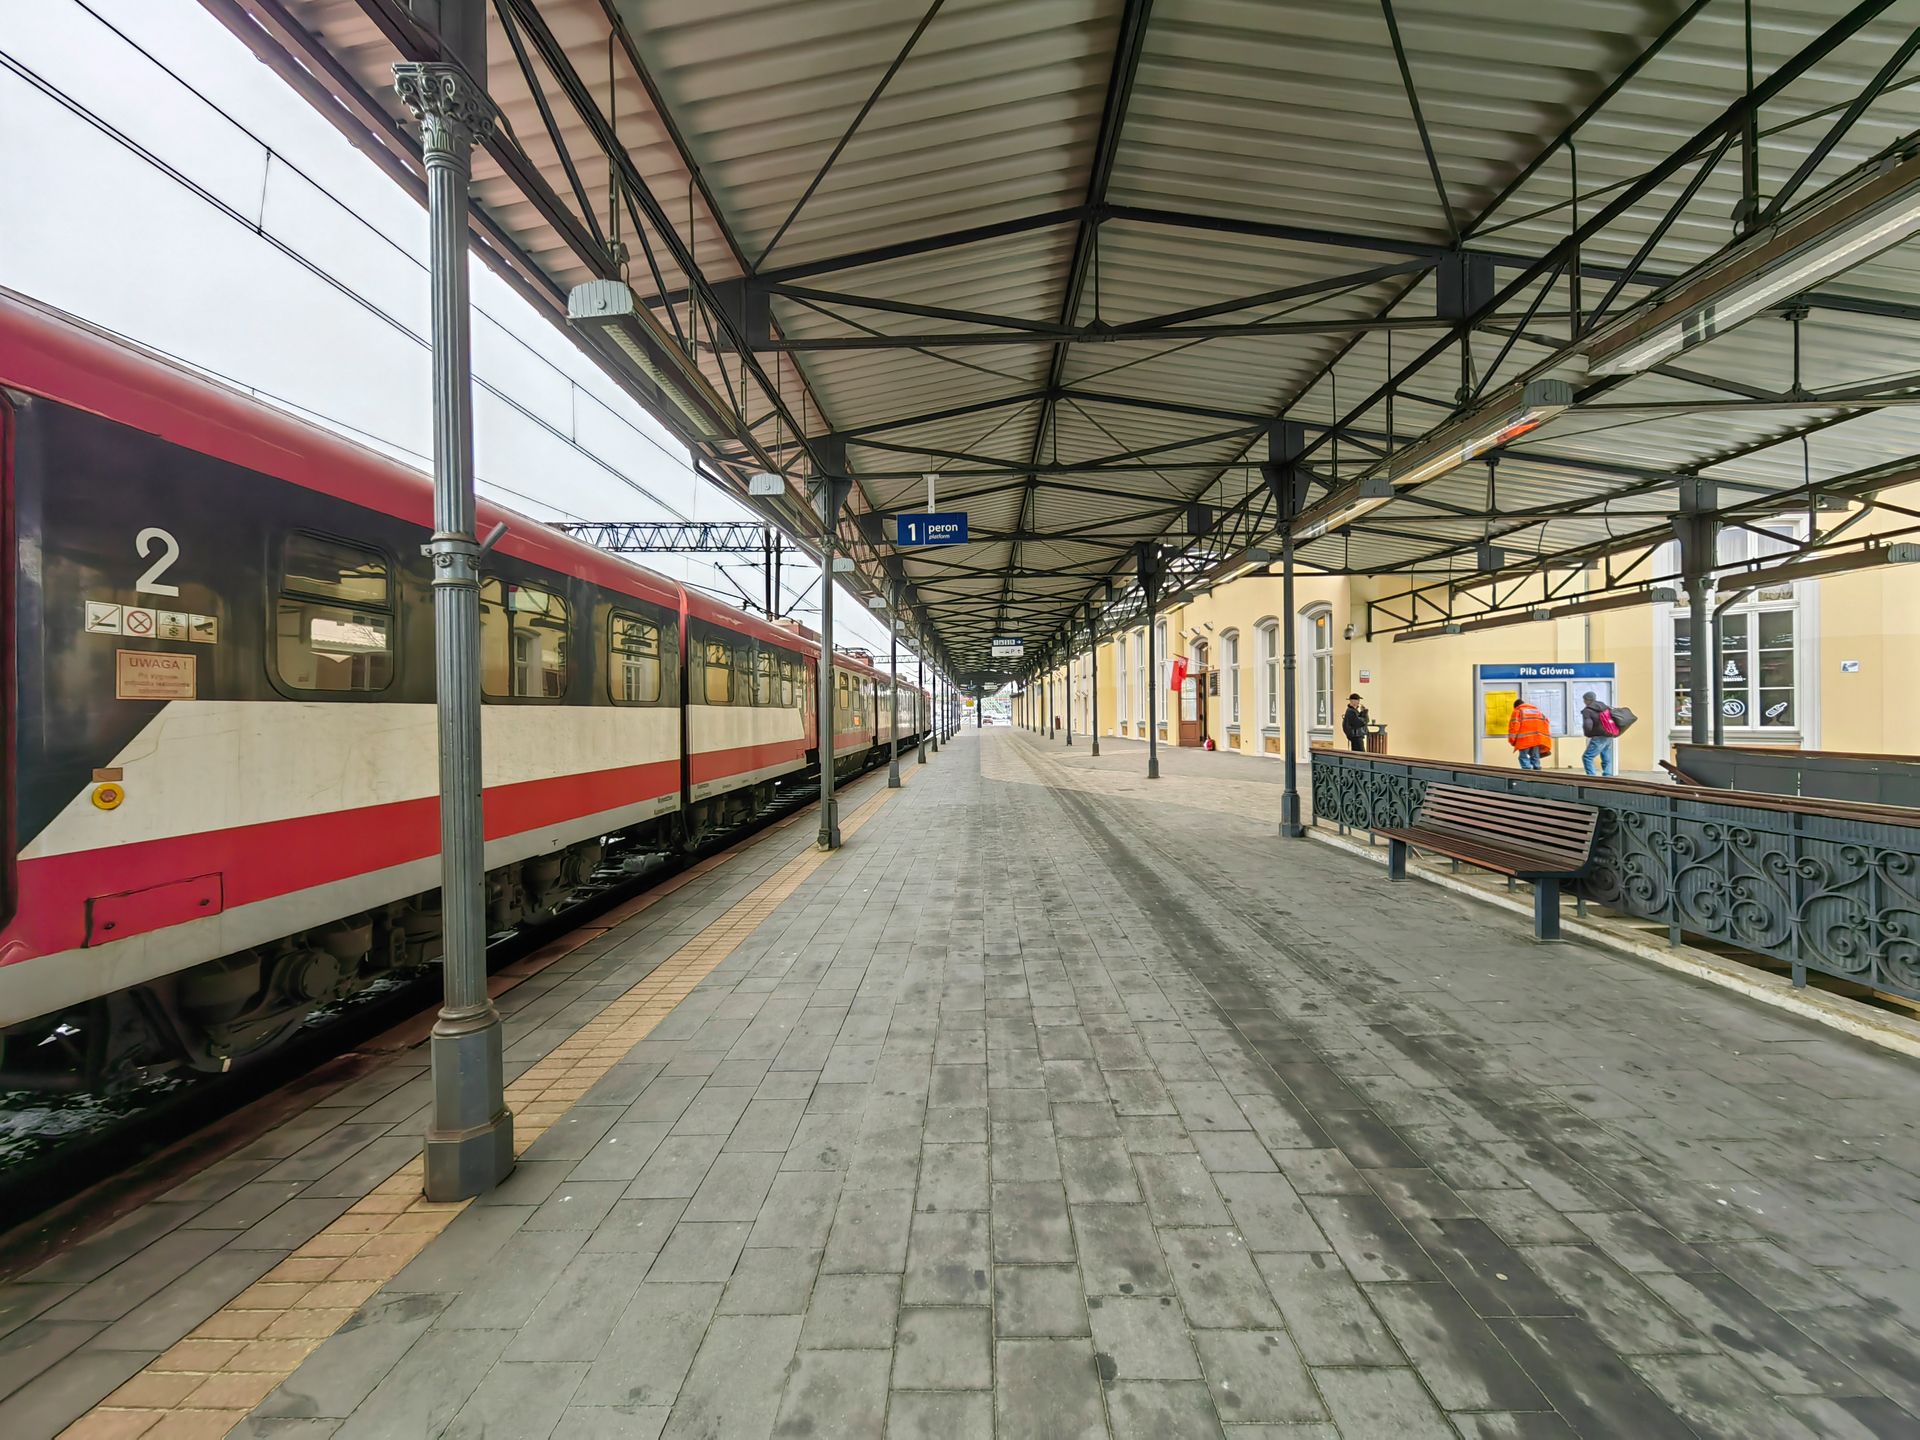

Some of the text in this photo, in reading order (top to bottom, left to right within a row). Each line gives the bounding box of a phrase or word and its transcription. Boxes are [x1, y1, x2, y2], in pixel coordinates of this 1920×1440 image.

[907, 523, 916, 541] 1
[928, 524, 958, 535] peron
[135, 527, 180, 597] 2
[129, 657, 180, 671] UWAGA
[1520, 666, 1575, 676] Piła Główna
